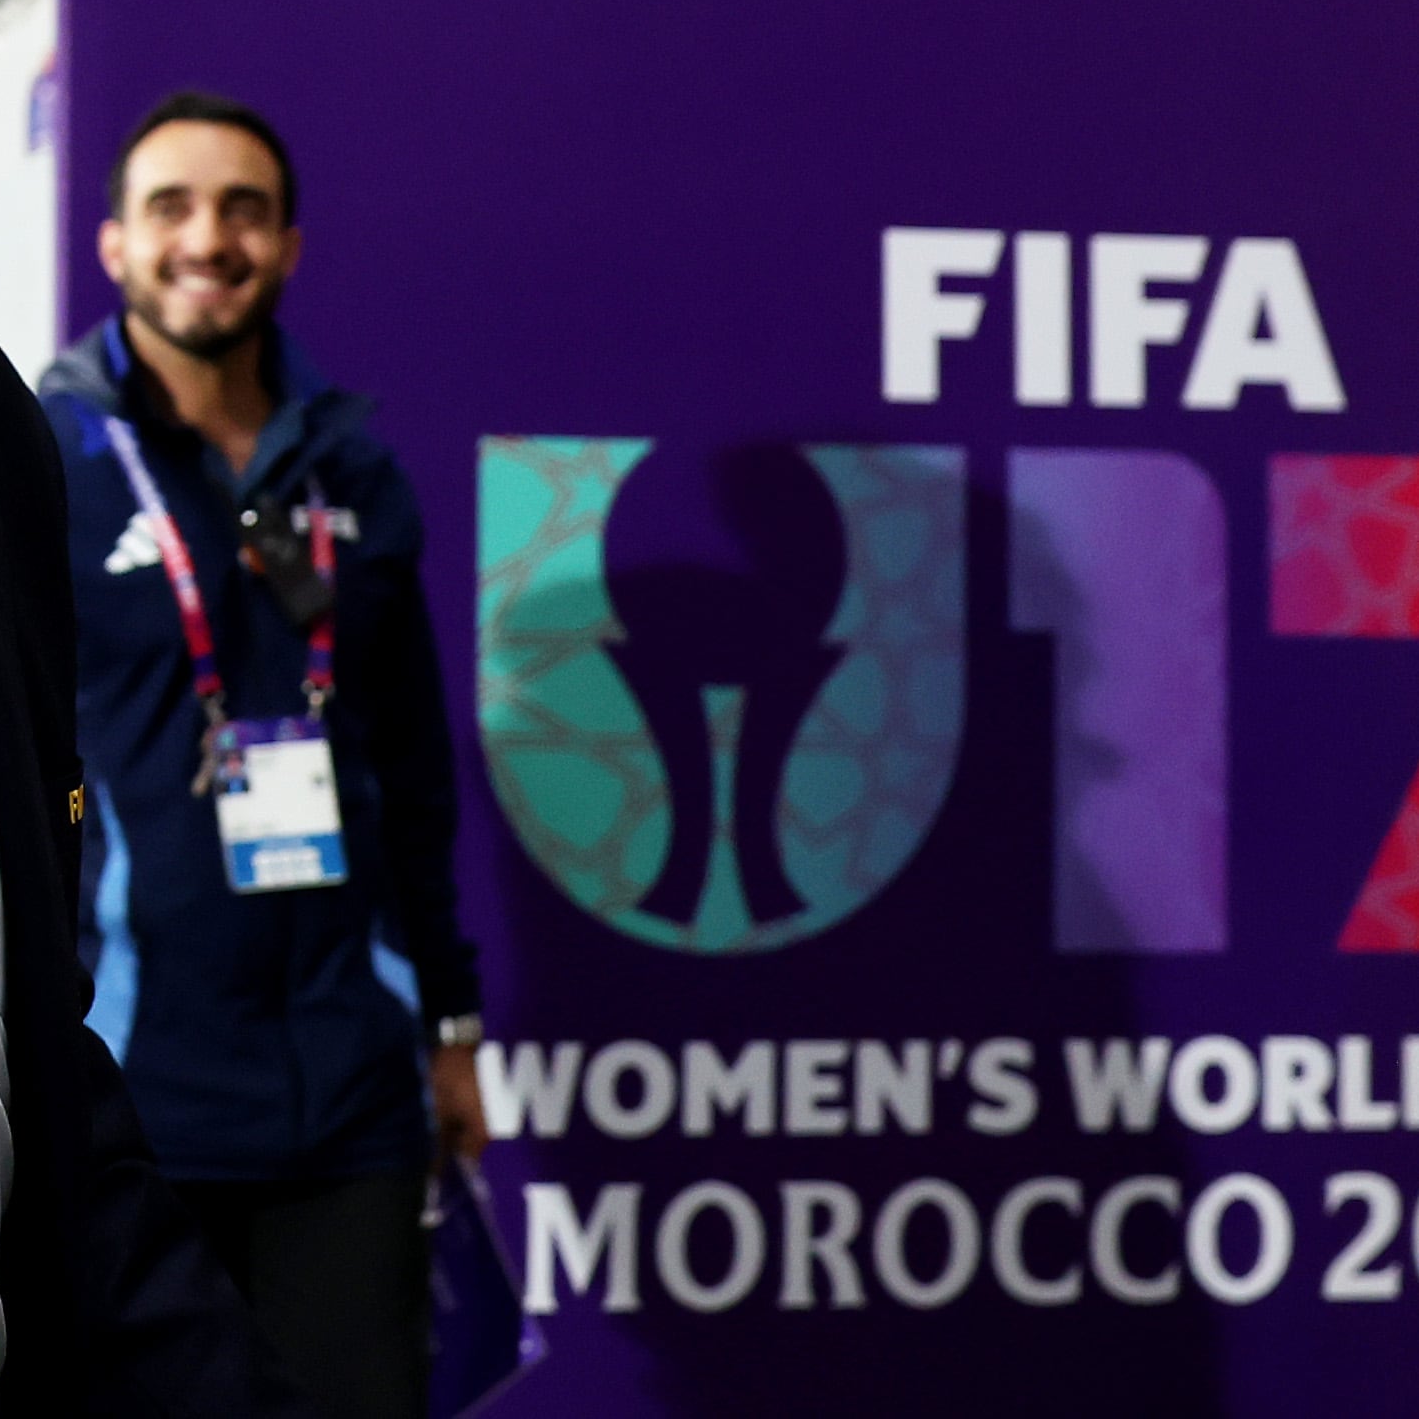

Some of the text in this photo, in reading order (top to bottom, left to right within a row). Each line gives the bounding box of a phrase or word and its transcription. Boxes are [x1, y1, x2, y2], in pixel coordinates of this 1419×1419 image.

[881, 226, 1347, 413] FIFA
[476, 1034, 1419, 1139] WOMEN'S WORL
[522, 1171, 1419, 1315] MOROCCO 2
